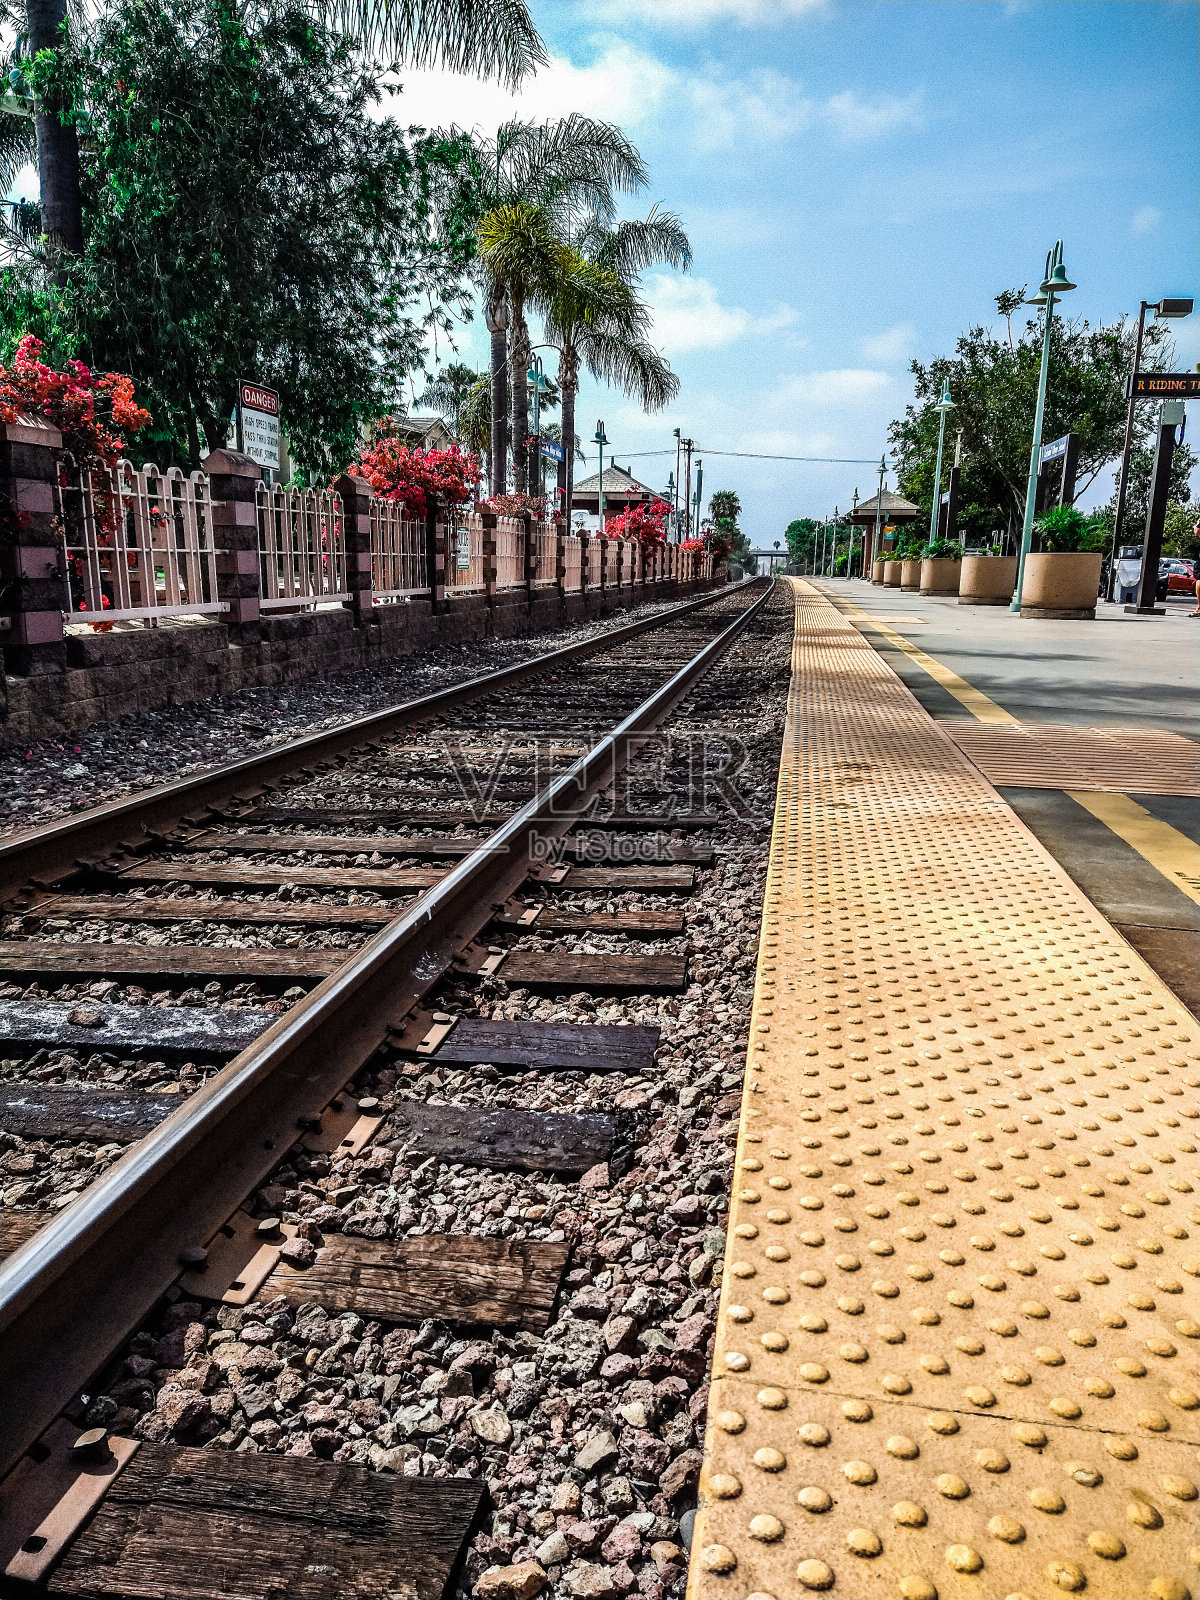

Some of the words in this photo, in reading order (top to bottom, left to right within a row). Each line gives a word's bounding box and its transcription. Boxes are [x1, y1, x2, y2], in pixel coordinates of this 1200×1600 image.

[1149, 380, 1187, 390] RIDING
[244, 389, 276, 410] DANGER
[255, 418, 267, 430] SPEED
[244, 430, 256, 442] PASS
